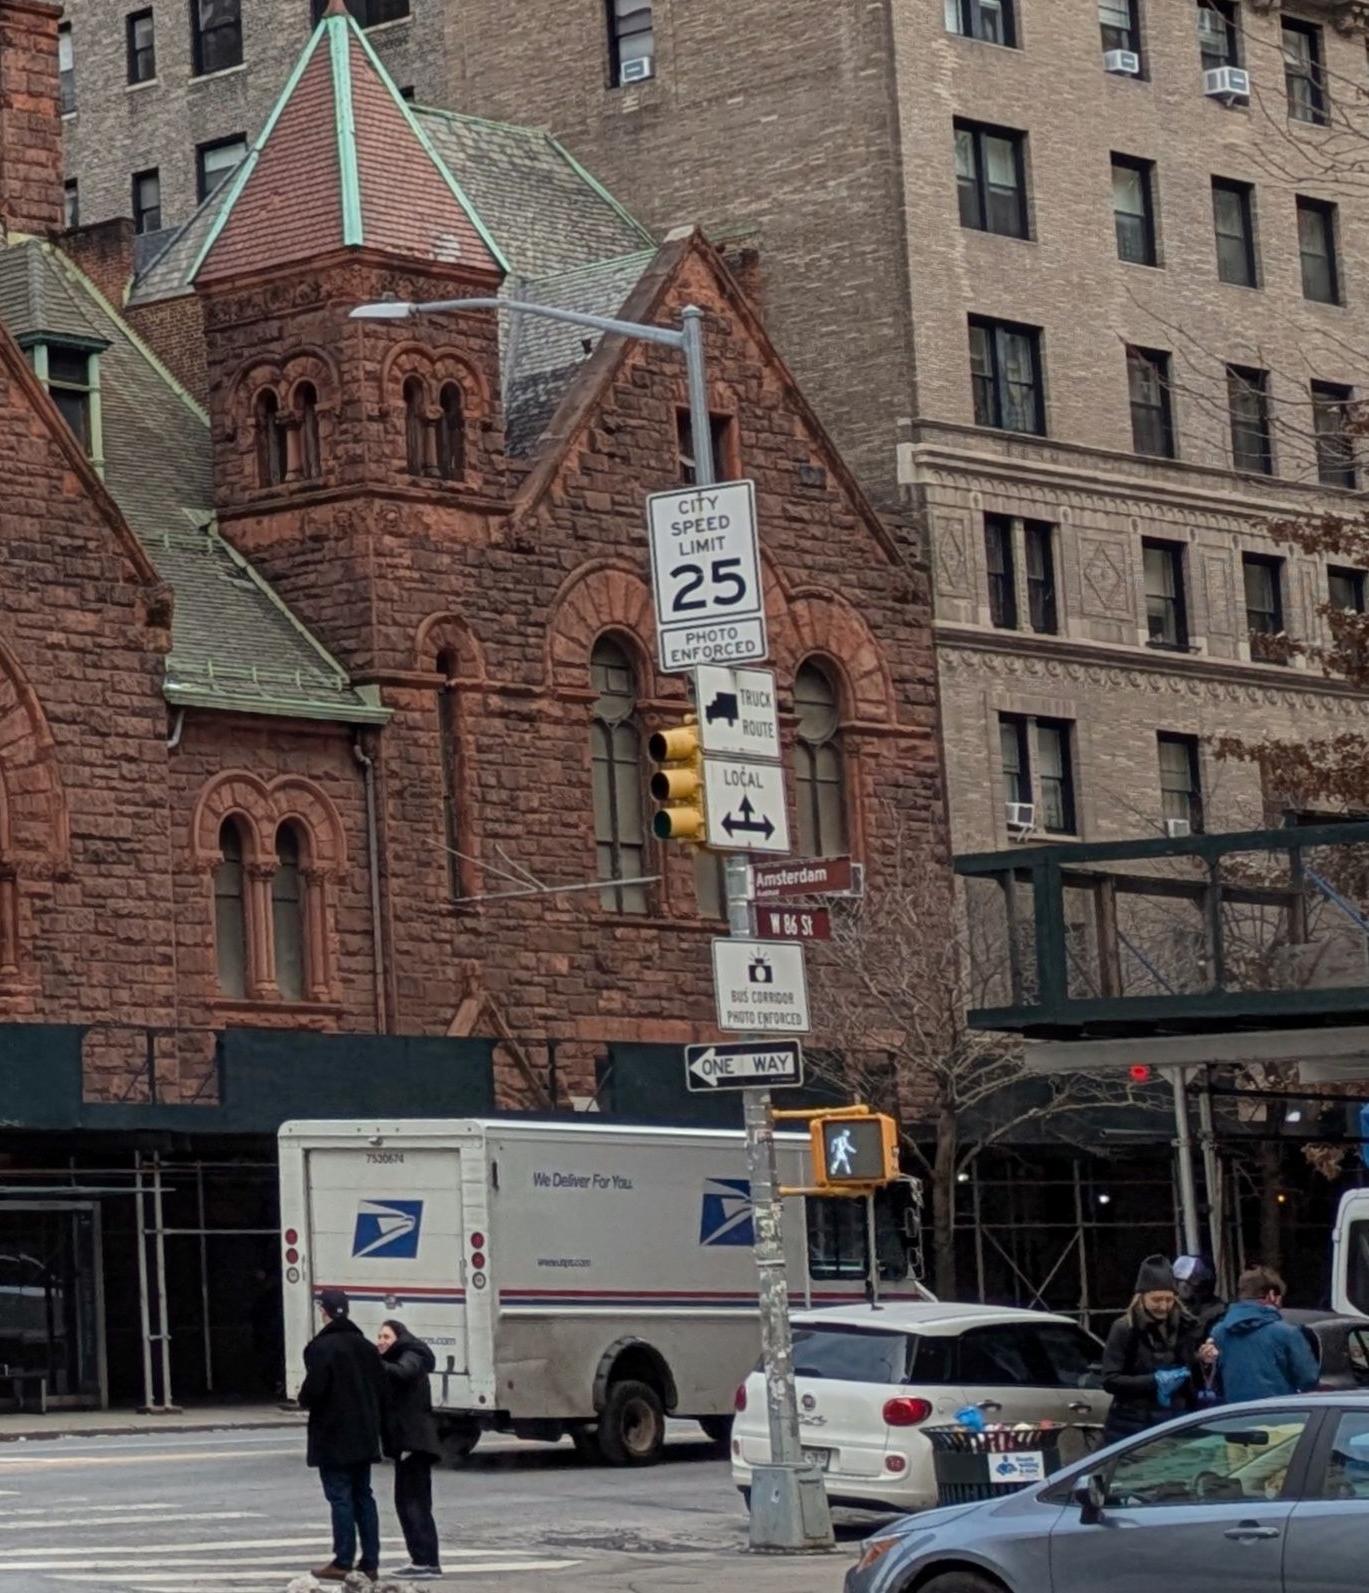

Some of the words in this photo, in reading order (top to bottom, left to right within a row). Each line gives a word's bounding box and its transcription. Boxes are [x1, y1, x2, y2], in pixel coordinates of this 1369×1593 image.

[678, 496, 719, 515] CITY
[671, 515, 730, 536] SPEED
[679, 536, 726, 556] LIMIT
[669, 557, 747, 612] 25
[685, 627, 738, 645] PHOTO
[671, 640, 756, 662] ENFORCED
[740, 688, 772, 708] TRUCK
[742, 719, 775, 739] ROUTE
[724, 769, 764, 789] LOCAL
[756, 868, 827, 887] Amsterdam
[769, 913, 781, 934] W
[783, 914, 798, 935] 86
[801, 915, 814, 936] St
[730, 989, 749, 1004] BUS
[751, 990, 794, 1005] CORRIDOR
[727, 1010, 755, 1024] PHOTO
[757, 1011, 802, 1026] ENFORCED
[702, 1058, 734, 1075] ONE
[753, 1055, 789, 1072] WAY
[534, 1172, 551, 1187] We
[553, 1172, 590, 1188] Deliver
[592, 1174, 610, 1189] For
